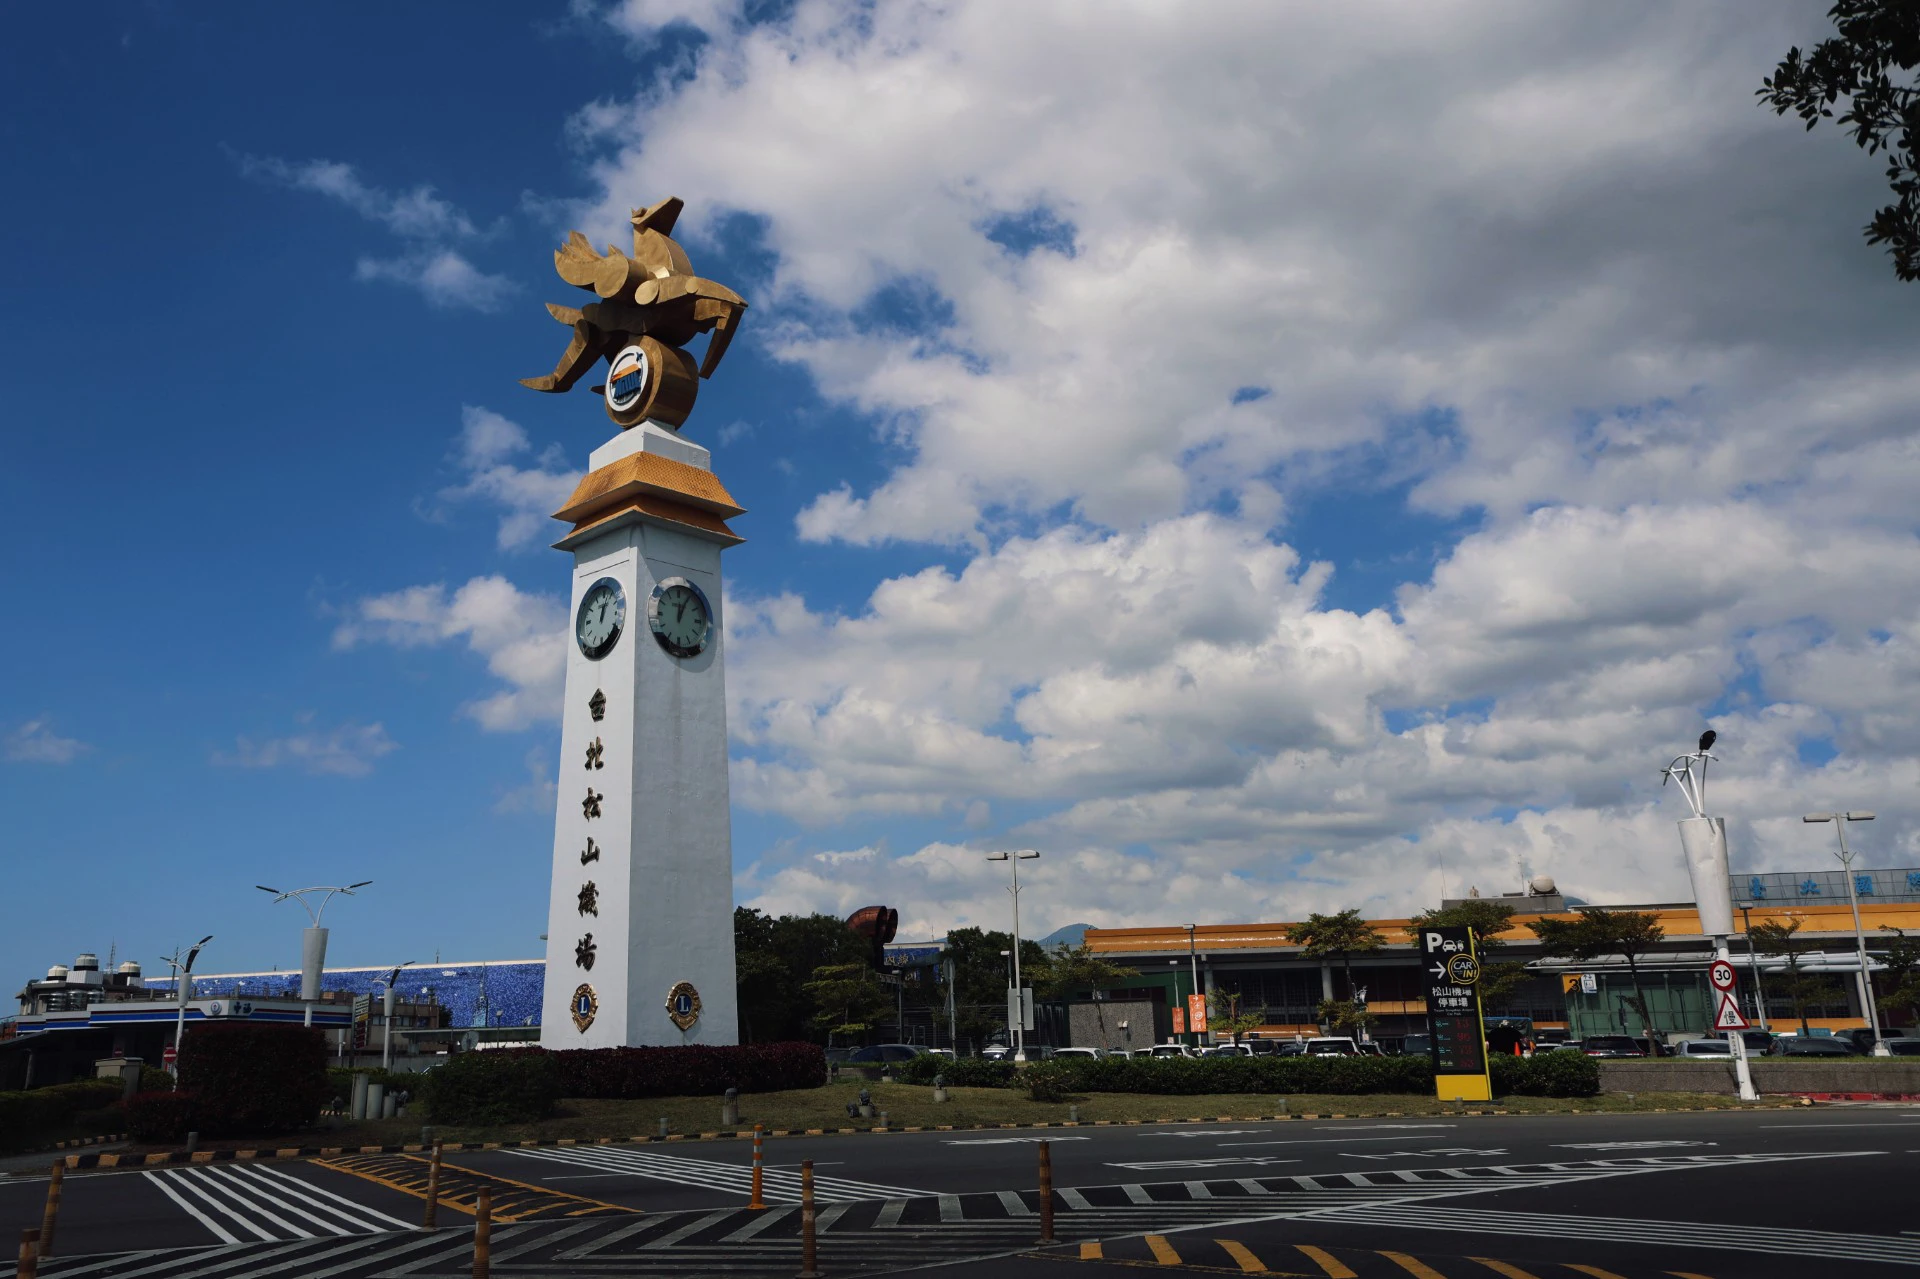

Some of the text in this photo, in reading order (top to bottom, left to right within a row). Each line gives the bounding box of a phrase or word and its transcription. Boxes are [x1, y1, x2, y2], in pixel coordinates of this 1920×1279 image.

[1426, 932, 1443, 952] P
[1453, 961, 1473, 970] CAR
[1463, 970, 1477, 978] IN!
[1715, 970, 1731, 981] 30
[1569, 978, 1581, 992] 3
[1432, 986, 1473, 997] 松山機場
[579, 996, 588, 1014] L
[679, 995, 689, 1013] L
[1438, 997, 1469, 1008] 停車場
[1724, 1010, 1737, 1025] 慢
